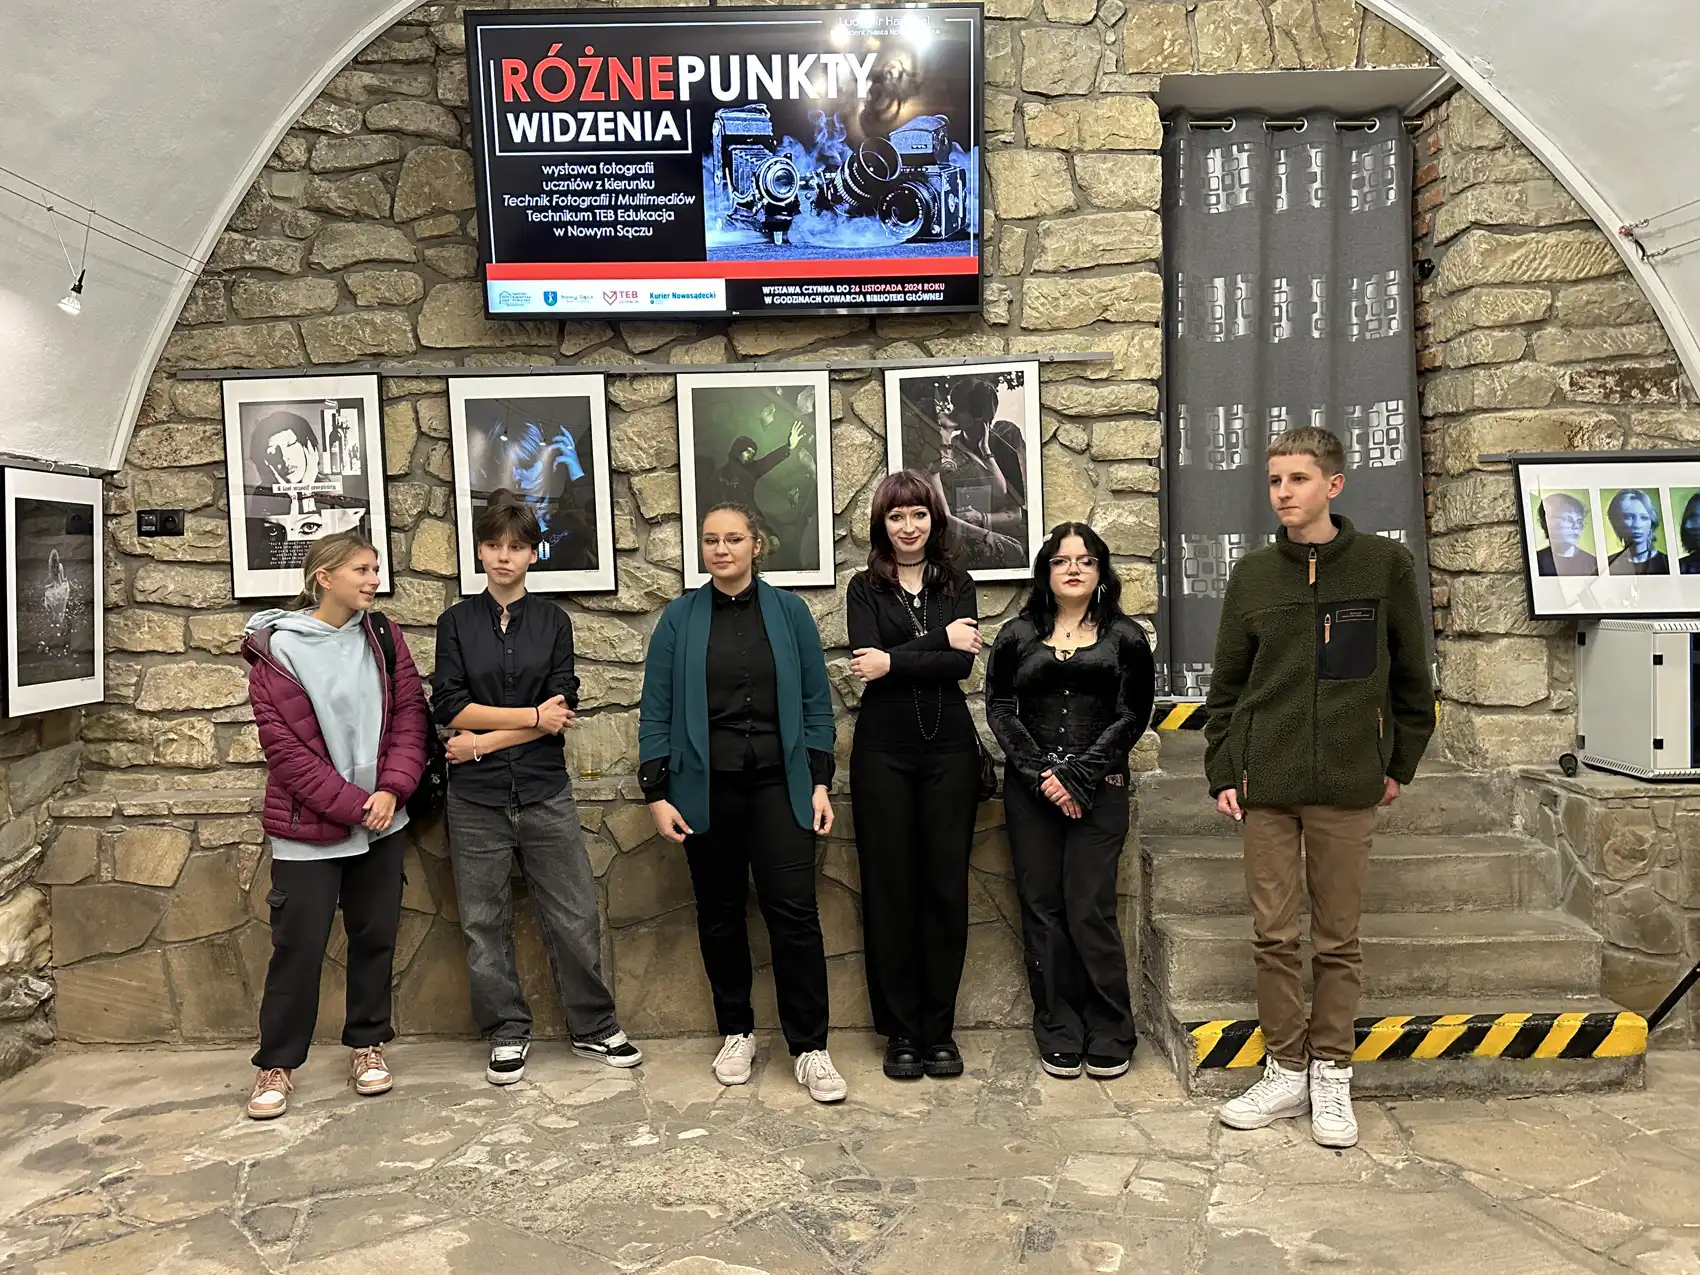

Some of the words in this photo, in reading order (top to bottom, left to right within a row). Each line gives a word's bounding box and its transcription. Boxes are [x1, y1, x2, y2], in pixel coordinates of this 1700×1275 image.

[506, 110, 681, 143] WIDZENIA
[541, 162, 596, 177] wystawa
[599, 161, 654, 177] fotografii
[542, 178, 594, 191] uczniów
[595, 180, 603, 190] z
[604, 177, 655, 190] kierunku
[503, 194, 550, 207] Technik
[552, 193, 610, 208] Fotografii
[611, 193, 616, 206] i
[617, 192, 696, 206] Multimediów
[526, 209, 593, 222] Technikum
[594, 209, 615, 221] TEB
[617, 208, 675, 223] Edukacja
[553, 227, 566, 237] w
[567, 225, 615, 239] Nowym
[616, 224, 653, 239] Sączu
[618, 290, 639, 299] TEB
[761, 285, 801, 294] WYSTAWA
[802, 284, 835, 293] CZYNNA
[836, 284, 849, 293] DO
[850, 284, 860, 293] 26
[861, 283, 903, 292] LISTOPADA
[904, 282, 922, 291] 2024
[923, 282, 945, 291] ROKU
[649, 291, 671, 300] Kurier
[671, 291, 716, 300] Nowosądecki
[763, 295, 773, 304] W
[773, 294, 822, 304] GODZINACH
[823, 294, 864, 303] OTWARCIA
[865, 292, 904, 302] BIBLIOTEKI
[905, 291, 944, 301] GŁÓWNEJ
